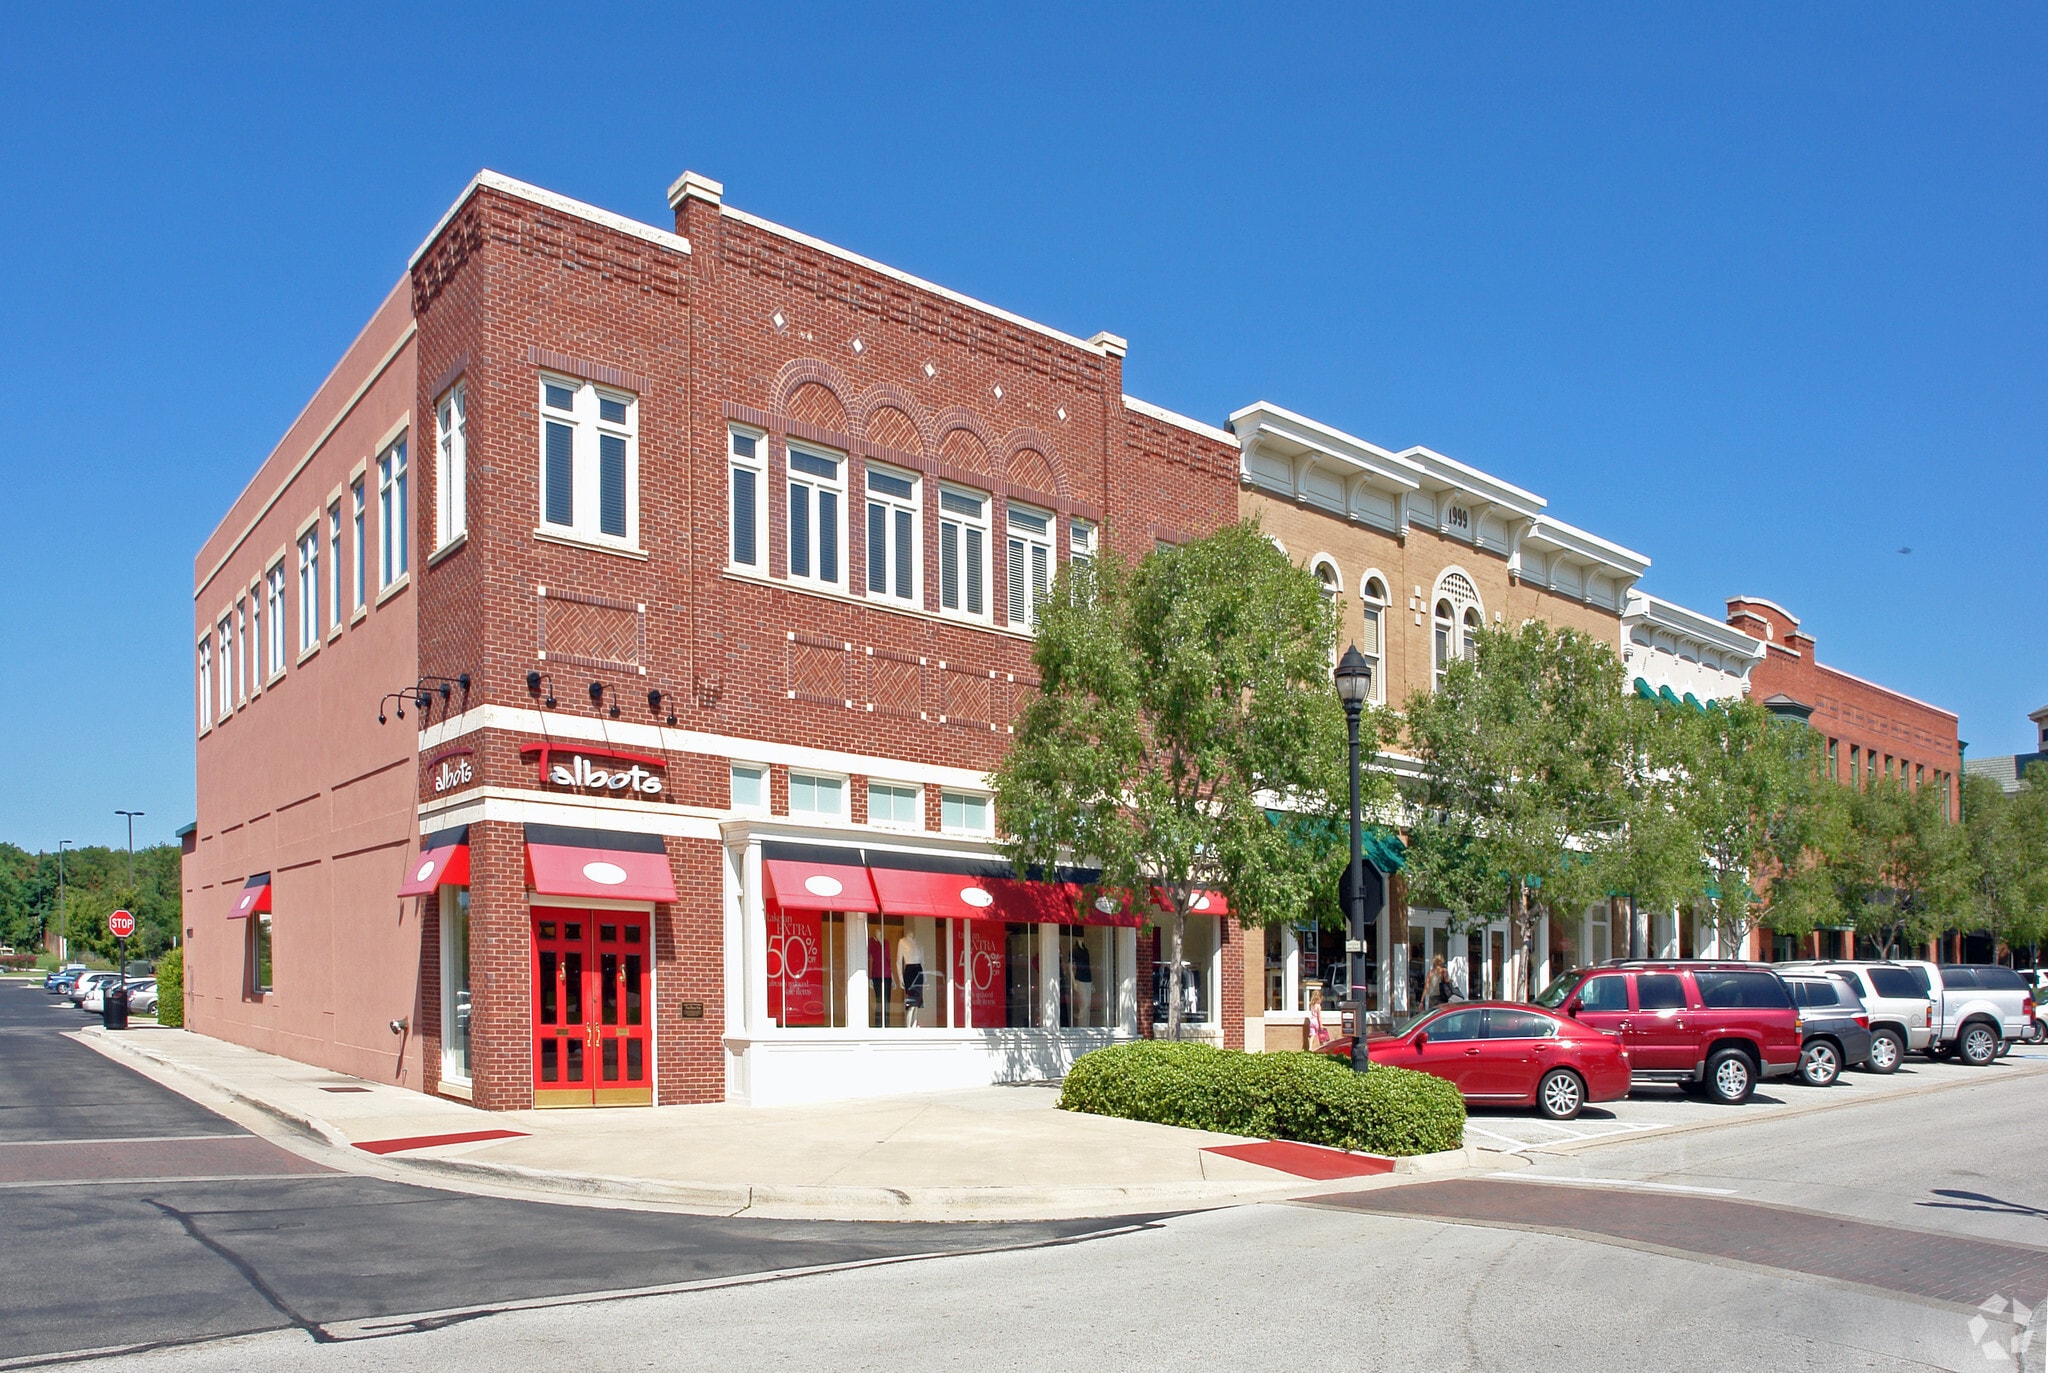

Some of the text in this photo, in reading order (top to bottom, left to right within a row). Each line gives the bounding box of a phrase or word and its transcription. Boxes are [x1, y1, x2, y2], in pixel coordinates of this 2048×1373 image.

[1448, 506, 1468, 529] 1999
[427, 747, 474, 793] Talbots
[520, 742, 668, 794] Talbots
[111, 918, 133, 929] STOP
[777, 922, 812, 937] EXTRA
